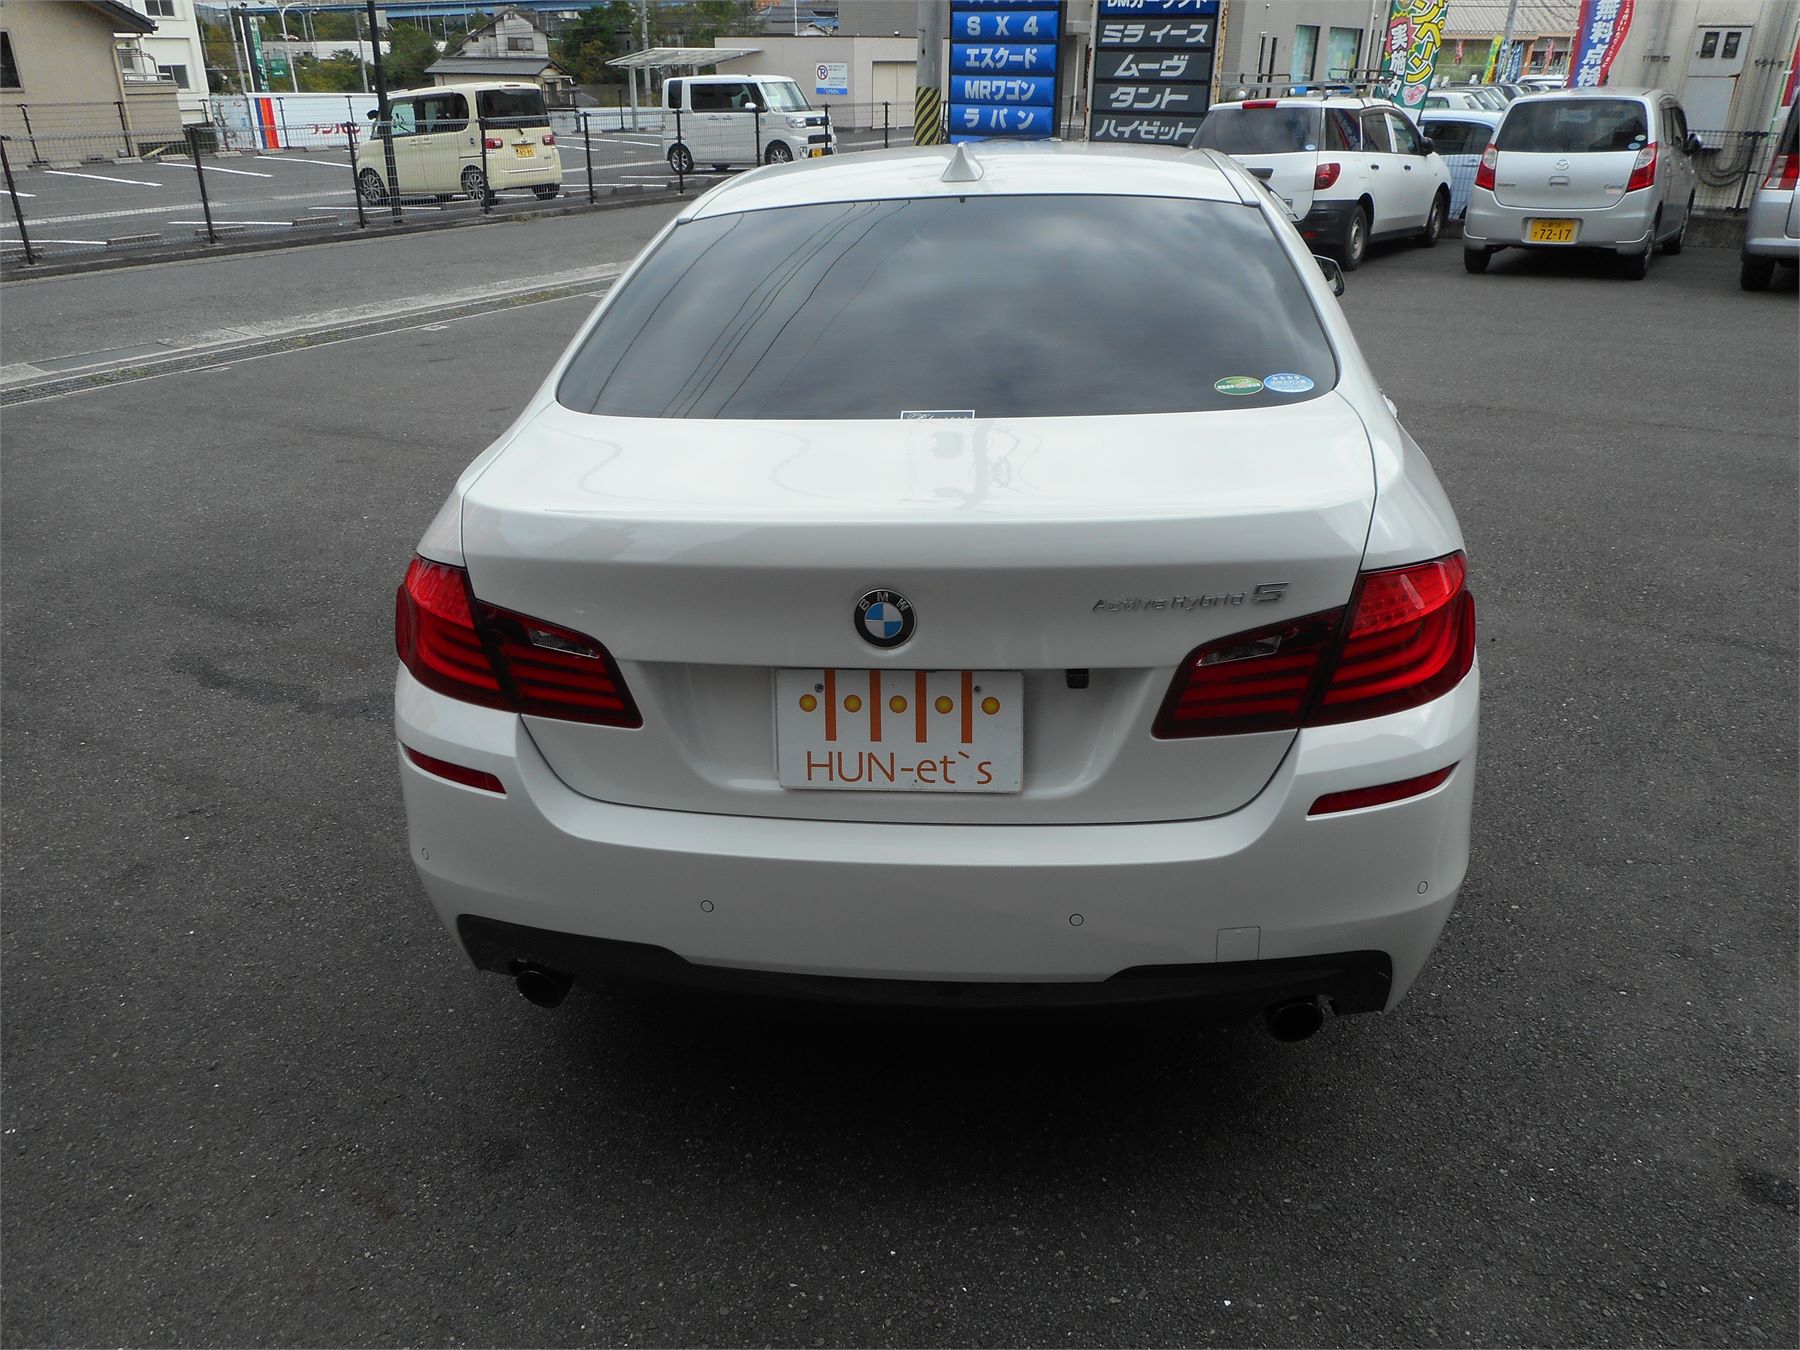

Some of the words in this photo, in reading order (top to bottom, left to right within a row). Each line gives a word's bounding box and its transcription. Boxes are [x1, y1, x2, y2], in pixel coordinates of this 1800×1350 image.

[1101, 24, 1209, 44] ミライース
[965, 48, 1038, 70] エスクード
[1113, 54, 1189, 78] ムーヴ
[964, 79, 1036, 101] MRワゴン
[1109, 86, 1189, 109] タント
[963, 108, 1035, 131] ラパン
[1095, 119, 1198, 141] ハイゼット
[1539, 228, 1572, 241] 72-17
[859, 591, 910, 612] BMW
